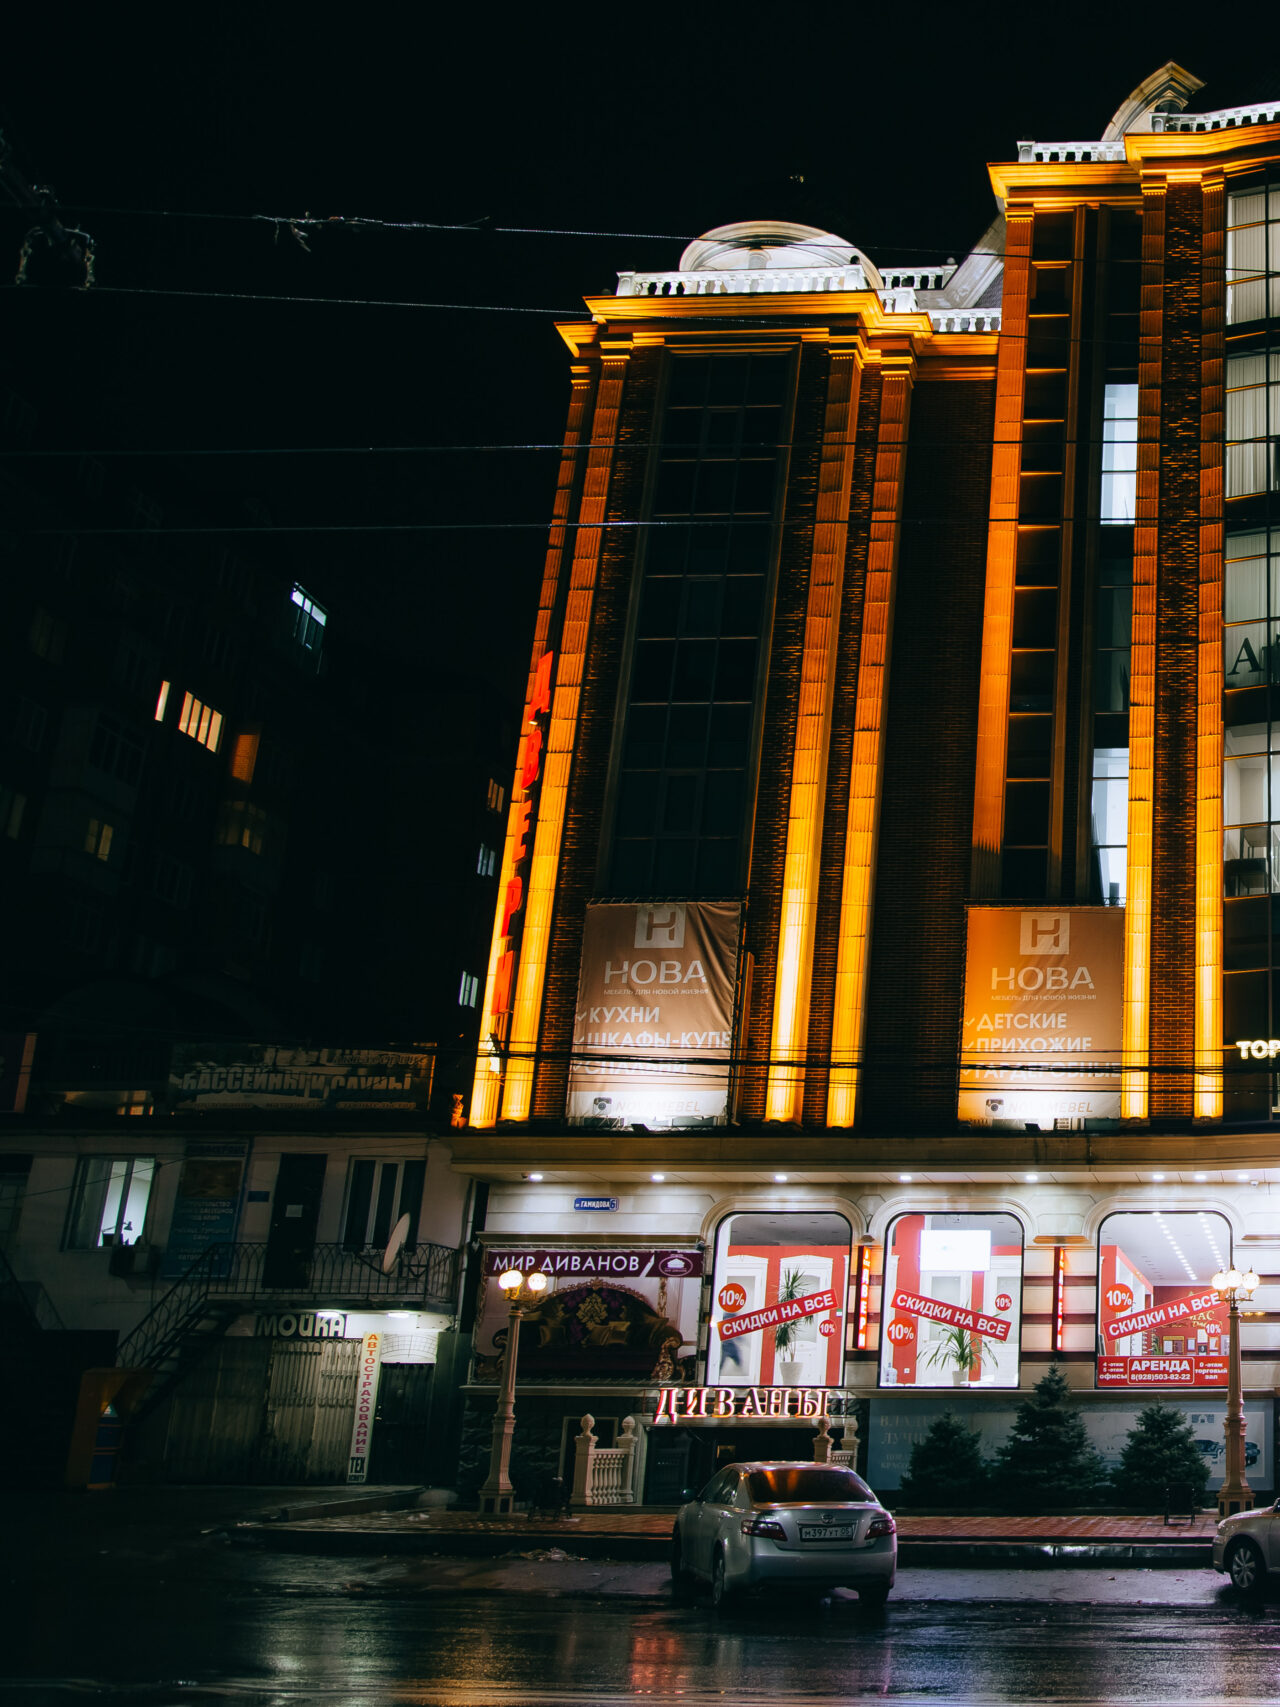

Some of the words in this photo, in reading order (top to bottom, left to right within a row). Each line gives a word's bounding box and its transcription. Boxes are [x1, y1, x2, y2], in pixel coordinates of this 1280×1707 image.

[491, 650, 554, 1015] ДВЕРИ
[604, 960, 707, 984] НОВА
[991, 967, 1095, 990] НОВА
[589, 1007, 660, 1024] КУХНИ
[976, 1013, 1067, 1032] ДЕТСКИЕ
[976, 1037, 1092, 1053] ПРИХОЖИЕ
[580, 1201, 609, 1209] ГАМИДОВА
[610, 1200, 616, 1209] 6
[493, 1255, 535, 1271] МИР
[540, 1255, 640, 1273] ДИВАНОВ
[719, 1289, 745, 1307] 10%
[995, 1297, 1012, 1307] 10%
[1106, 1290, 1132, 1306] 10%
[721, 1311, 779, 1336] СКИДКИ
[780, 1305, 803, 1320] НА
[804, 1293, 834, 1312] ВСЕ
[896, 1293, 952, 1318] СКИДКИ
[954, 1310, 974, 1325] НА
[976, 1316, 1007, 1336] ВСЕ
[1108, 1309, 1166, 1336] СКИДКИ
[1167, 1303, 1190, 1317] НА
[1190, 1291, 1222, 1312] ВСЕ
[256, 1315, 346, 1337] МОЙКА
[819, 1322, 836, 1334] 10%
[888, 1323, 915, 1340] 10%
[1206, 1323, 1221, 1335] 10%
[1131, 1360, 1190, 1373] АРЕНДА
[1195, 1367, 1228, 1375] торговый
[1099, 1373, 1128, 1381] офисы
[1131, 1374, 1191, 1382] 8(928)503-82-22
[355, 1333, 378, 1454] АВТОСТРАХОВАНИЕ
[653, 1387, 831, 1424] ДИВАНЫ
[350, 1457, 365, 1474] ТЕХ
